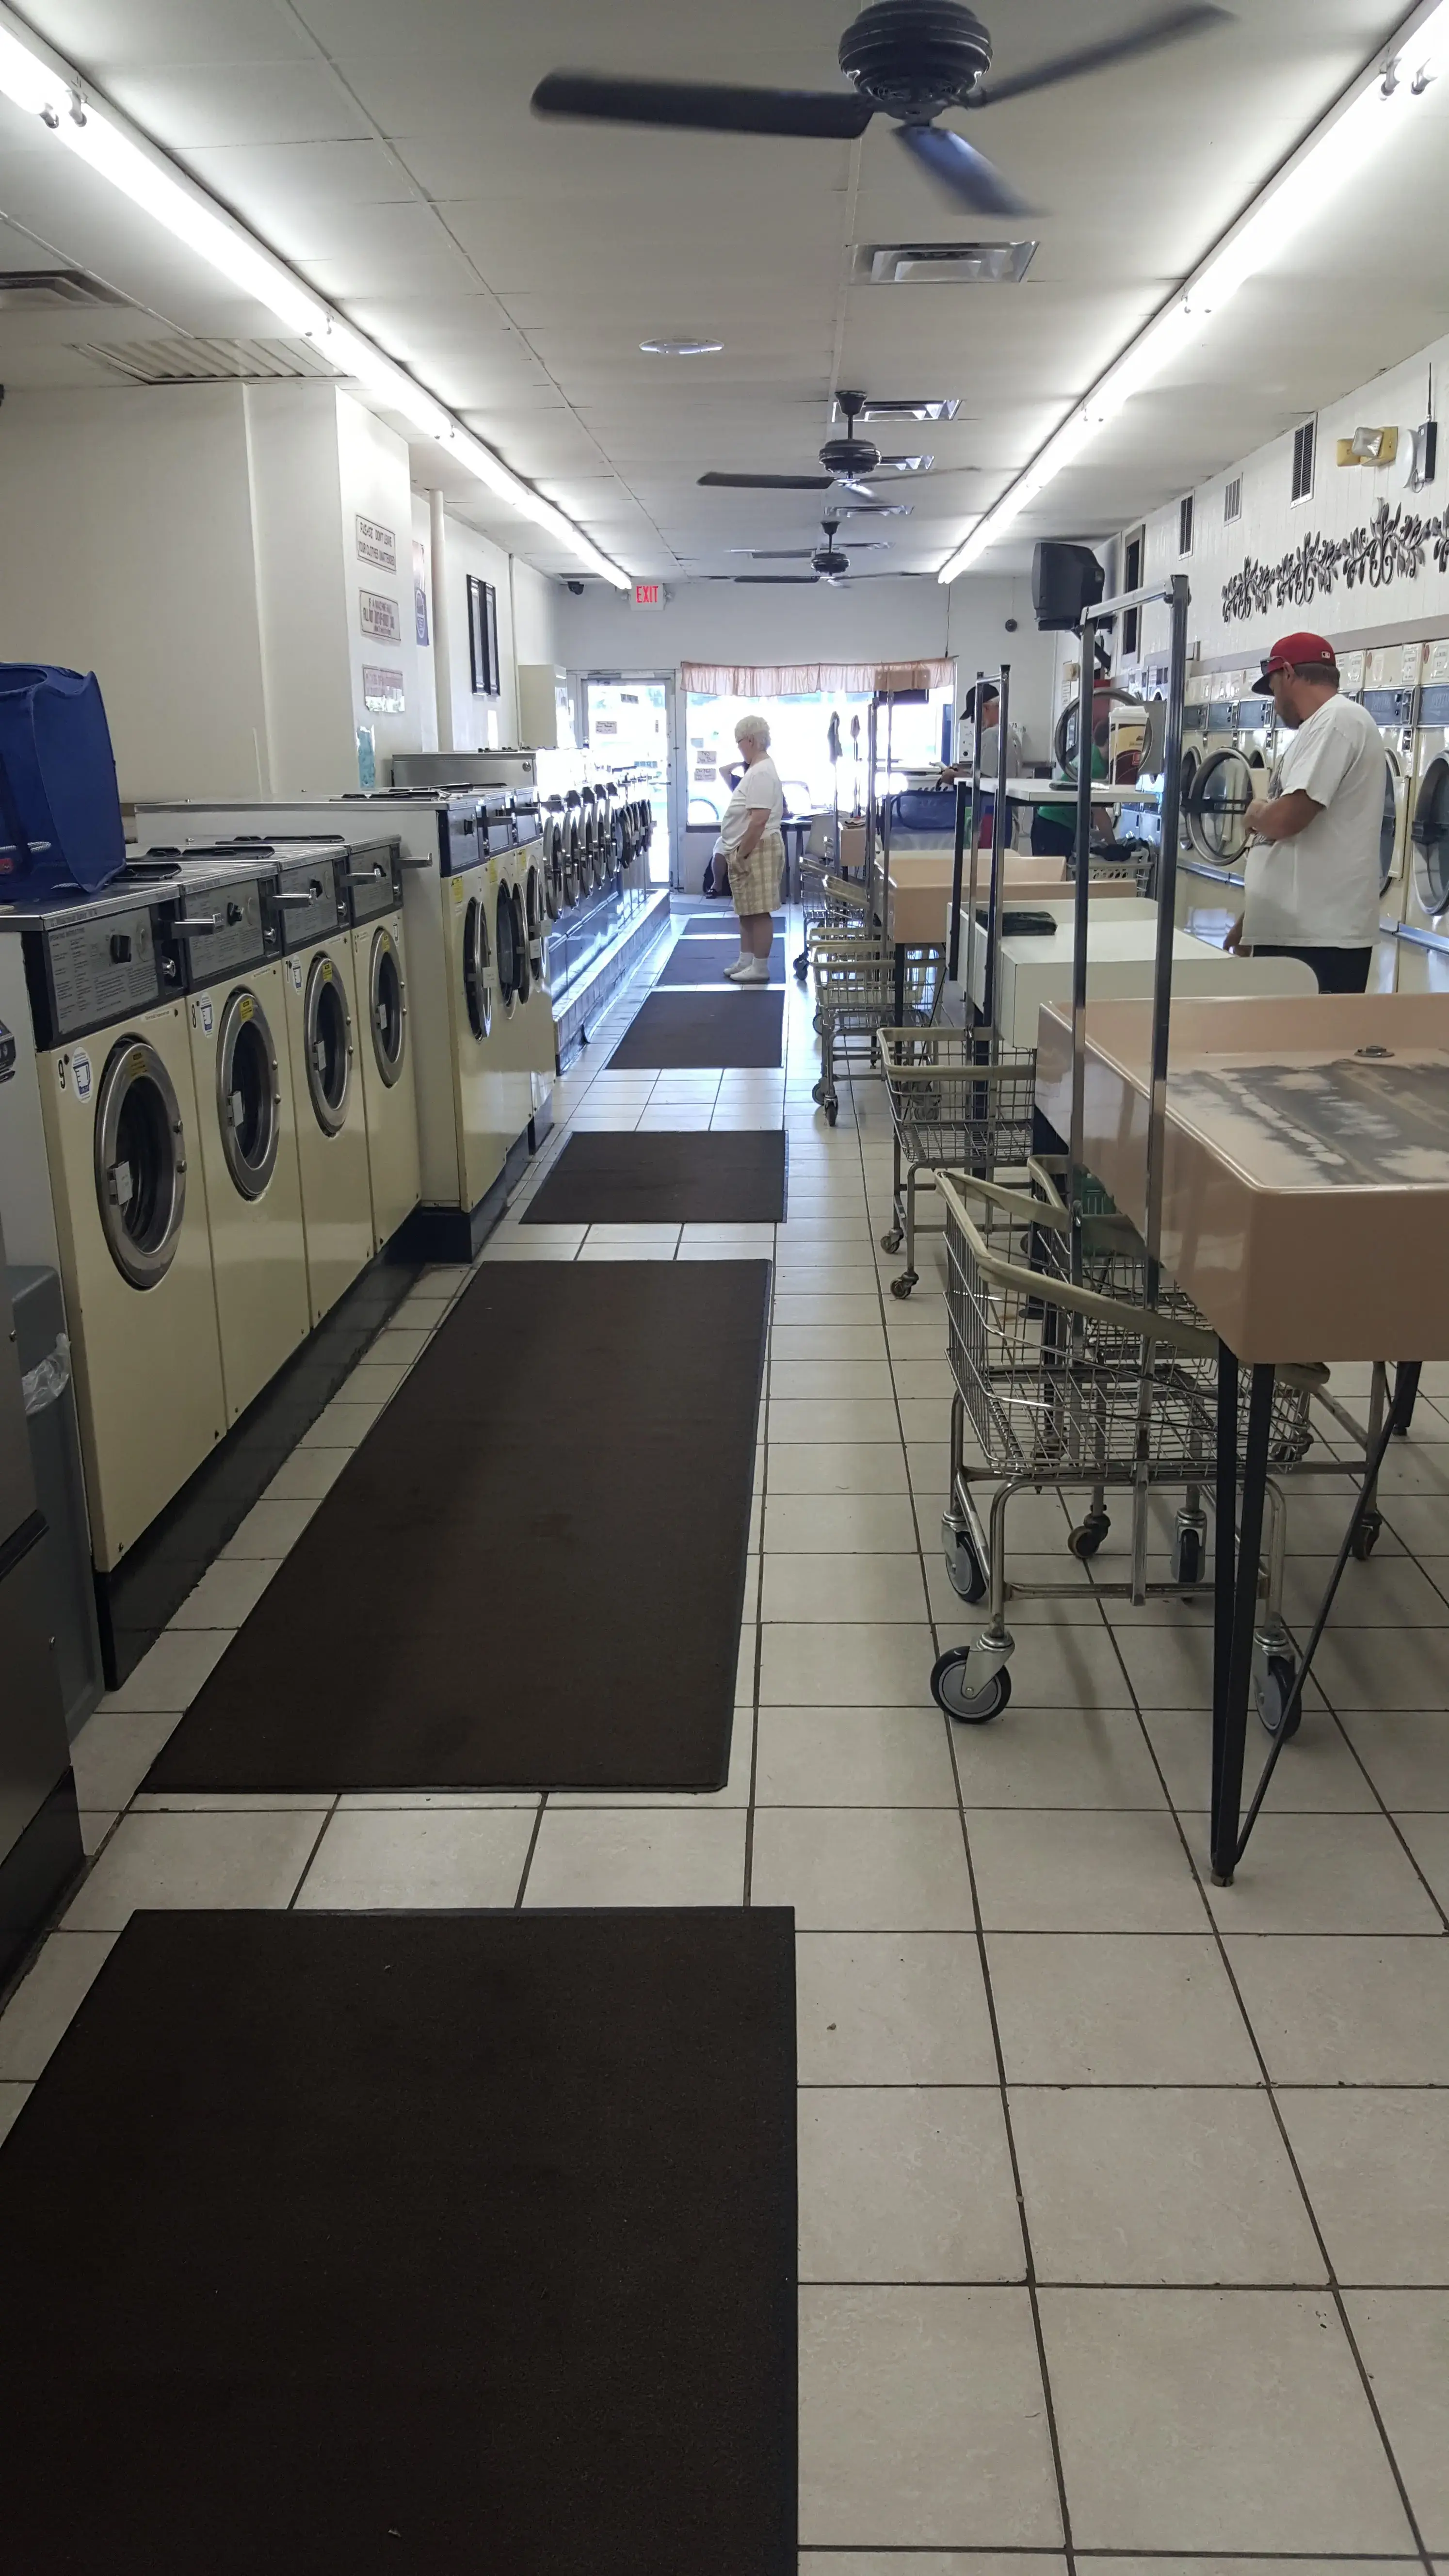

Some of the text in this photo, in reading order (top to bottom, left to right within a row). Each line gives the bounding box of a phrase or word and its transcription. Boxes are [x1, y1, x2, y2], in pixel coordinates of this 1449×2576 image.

[636, 586, 659, 603] EXIT
[192, 1004, 196, 1029] 8
[58, 1059, 65, 1089] 9
